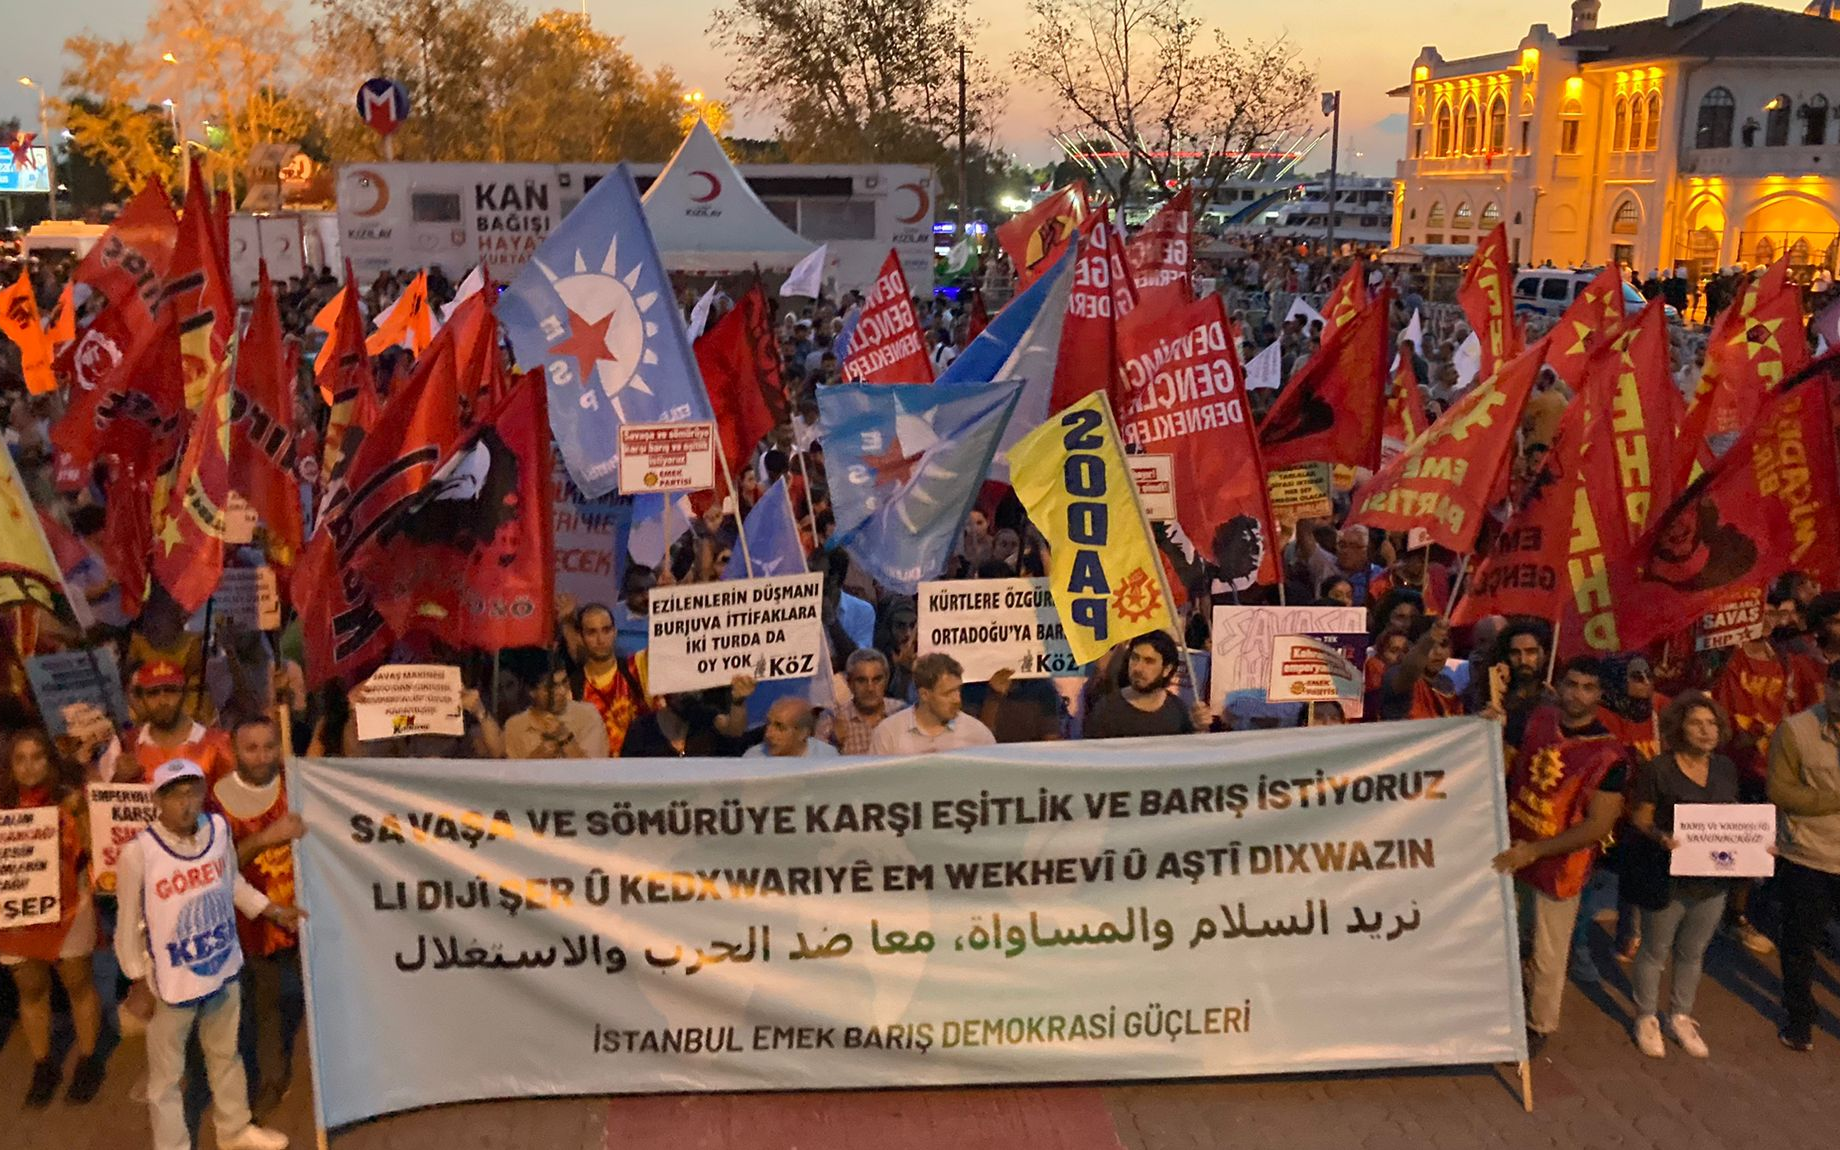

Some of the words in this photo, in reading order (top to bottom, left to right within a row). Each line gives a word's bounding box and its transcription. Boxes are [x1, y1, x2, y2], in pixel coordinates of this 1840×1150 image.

[475, 184, 549, 211] KAN
[477, 213, 550, 234] BAĞIŞI
[652, 588, 748, 615] EZİLENLERİN
[753, 583, 819, 606] DÜŞMANI
[929, 589, 1000, 612] KÜRTLERE
[654, 616, 721, 637] BURJUVA
[727, 605, 817, 627] İTTİFAKLARA
[932, 621, 1032, 646] ORTADOĞU'YA
[686, 634, 706, 654] İKİ
[712, 632, 760, 651] TURDA
[766, 629, 786, 644] DA
[697, 658, 717, 673] OY
[722, 654, 752, 671] YOK
[351, 809, 516, 848] SAVAŞA
[527, 808, 578, 838] VE
[585, 799, 796, 837] SÖMÜRÜYE
[805, 801, 921, 838] KARŞI
[932, 788, 1073, 834] EŞİTLİK
[1084, 791, 1131, 820] VE
[1140, 783, 1249, 818] BARIŞ
[1258, 769, 1447, 811] İSTİYORUZ
[373, 881, 407, 911] LI
[499, 878, 575, 917] ŞER
[584, 867, 610, 907] Û
[620, 859, 874, 905] KEDXWARIYÊ
[883, 863, 934, 892] EM
[945, 849, 1118, 890] WEKHEVÎ
[1123, 847, 1147, 882] Û
[1156, 840, 1242, 885] AŞTÎ
[1250, 837, 1436, 876] DIXWAZIN
[4, 895, 57, 920] SEP
[1190, 898, 1329, 949] السلام
[1346, 899, 1421, 941] نريد
[644, 924, 770, 975] الحرب
[788, 926, 854, 961] ضد
[871, 918, 936, 955] معا
[395, 934, 627, 975] والاستغلال
[594, 1023, 743, 1053] İSTANBUL
[753, 1026, 837, 1051] EMEK
[844, 1022, 934, 1054] BARIŞ
[942, 1005, 1116, 1048] DEMOKRASİ
[1124, 998, 1251, 1042] GÜÇLERİ
